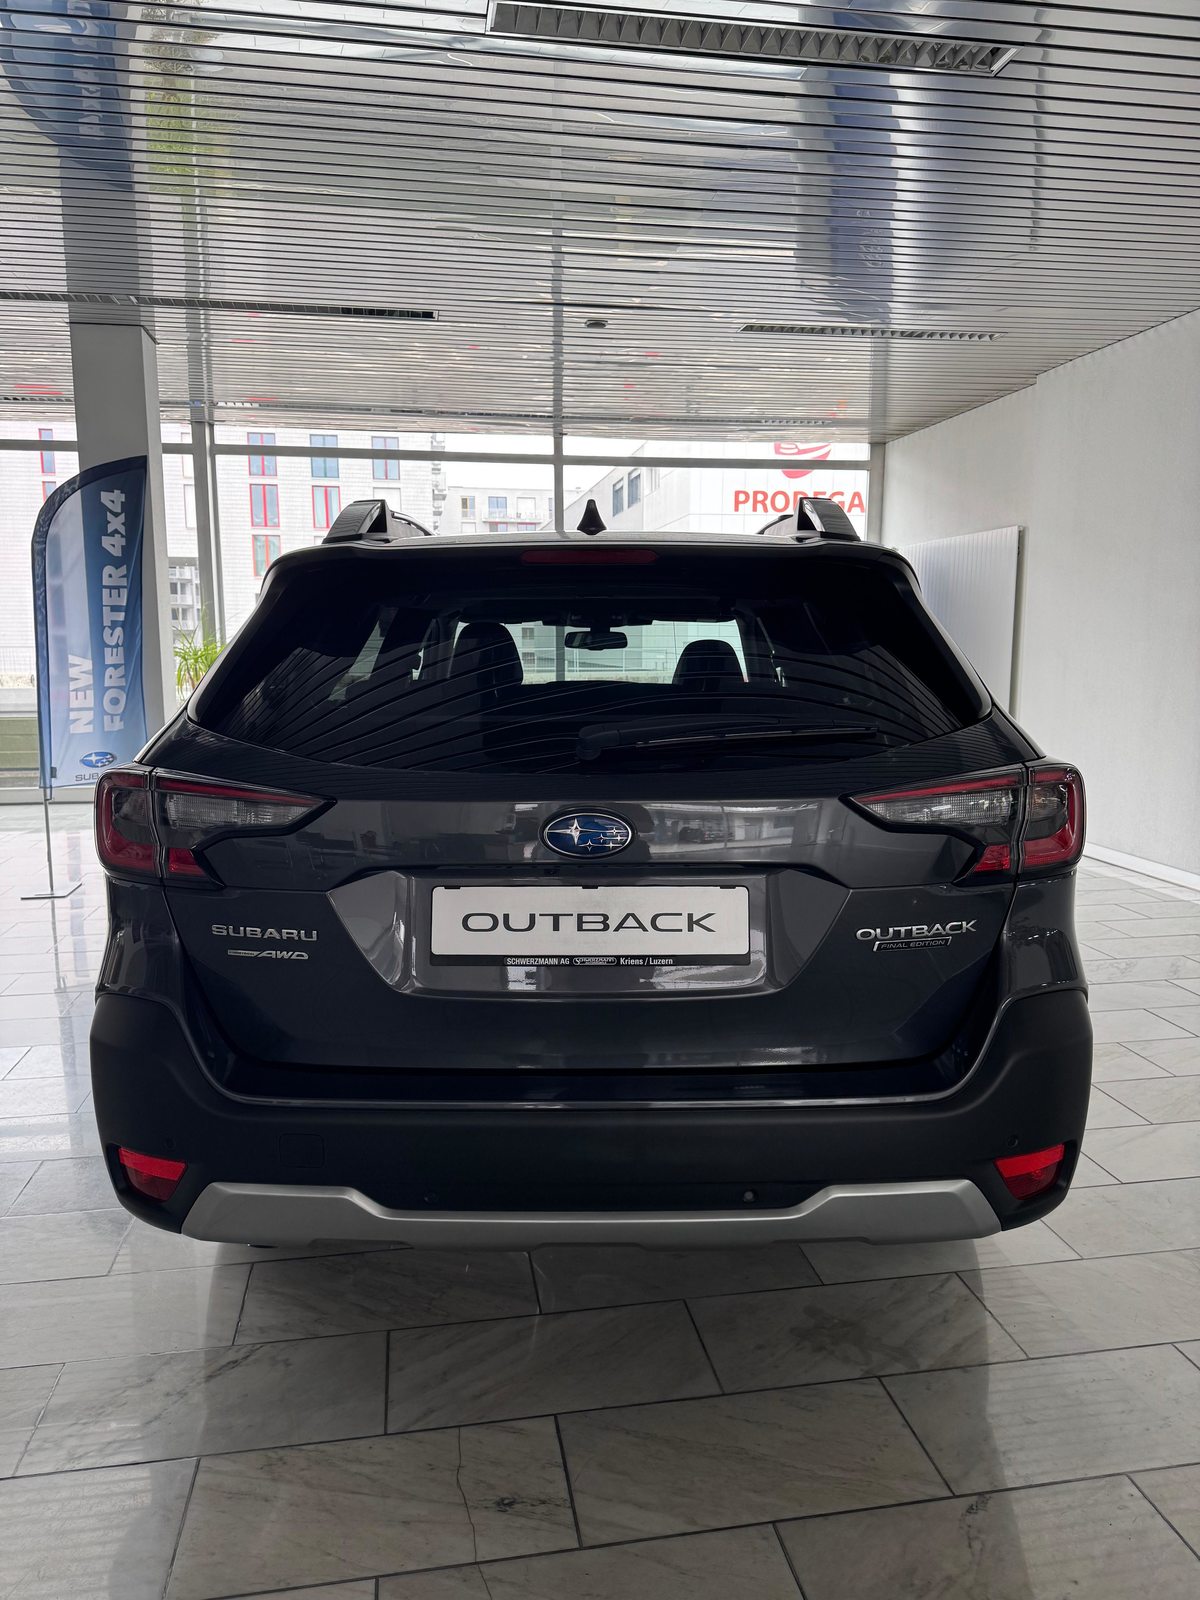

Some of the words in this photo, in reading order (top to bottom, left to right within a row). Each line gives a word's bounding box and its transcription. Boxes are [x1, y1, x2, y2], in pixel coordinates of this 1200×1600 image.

[734, 490, 865, 513] PROGA
[100, 489, 127, 557] 4x4
[101, 564, 128, 732] FORESTER
[67, 654, 94, 734] NEW
[75, 772, 100, 782] SUB
[461, 912, 716, 932] OUTBACK
[855, 919, 977, 941] OUTBACK
[211, 924, 318, 941] SUBARU
[909, 939, 946, 947] EDITION
[257, 950, 309, 960] AWD
[506, 957, 558, 965] SCHWERZMANN
[560, 957, 570, 965] AG
[619, 957, 644, 966] Kriens
[649, 957, 674, 966] Luzern
